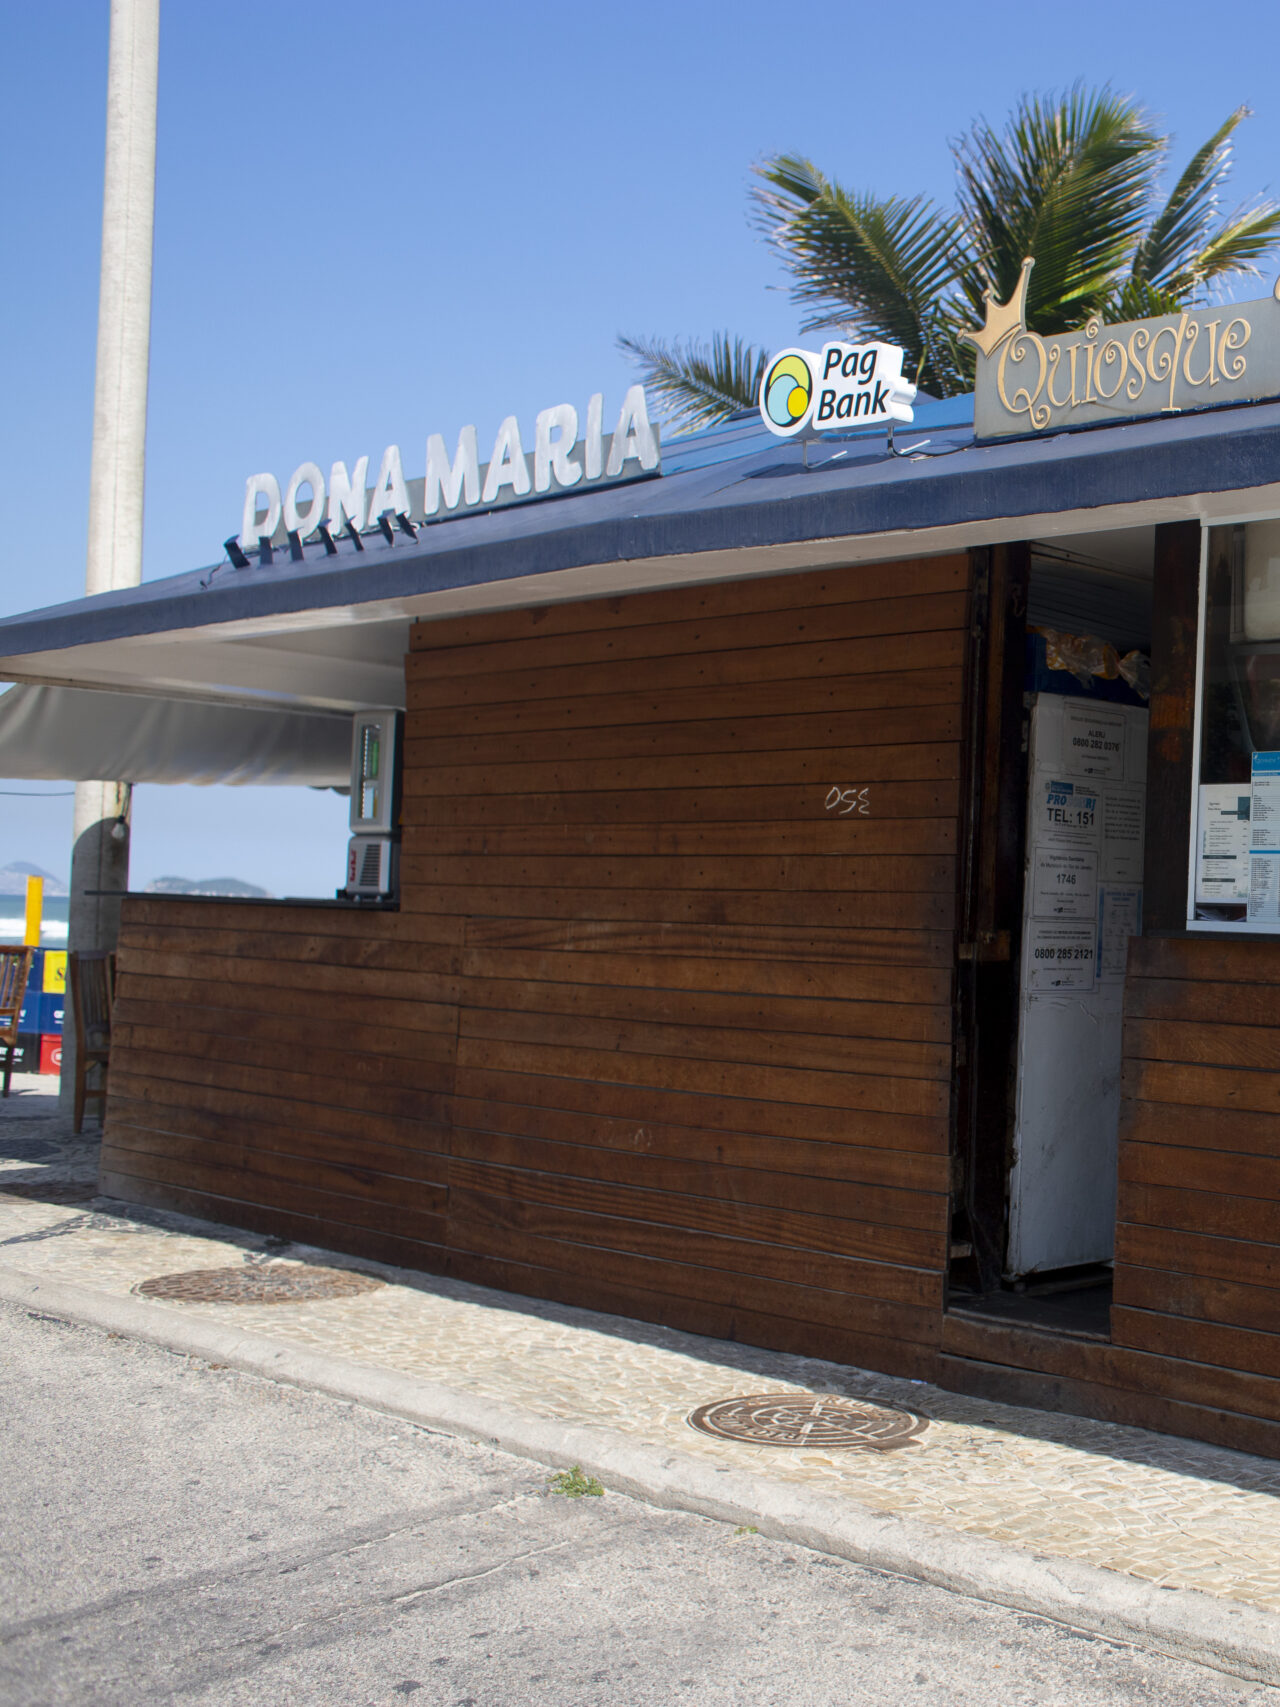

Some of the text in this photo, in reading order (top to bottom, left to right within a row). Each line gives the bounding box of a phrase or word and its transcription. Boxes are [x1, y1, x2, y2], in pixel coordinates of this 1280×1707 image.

[823, 348, 878, 385] Pag
[997, 313, 1251, 430] Quiosque
[817, 380, 889, 421] Bank
[242, 384, 659, 547] DONA MARIA
[1072, 737, 1089, 748] 0800
[1090, 740, 1102, 749] 282
[1047, 808, 1095, 825] TEL: 151
[1056, 873, 1076, 885] 1746
[1035, 948, 1093, 960] 0800 285 2121
